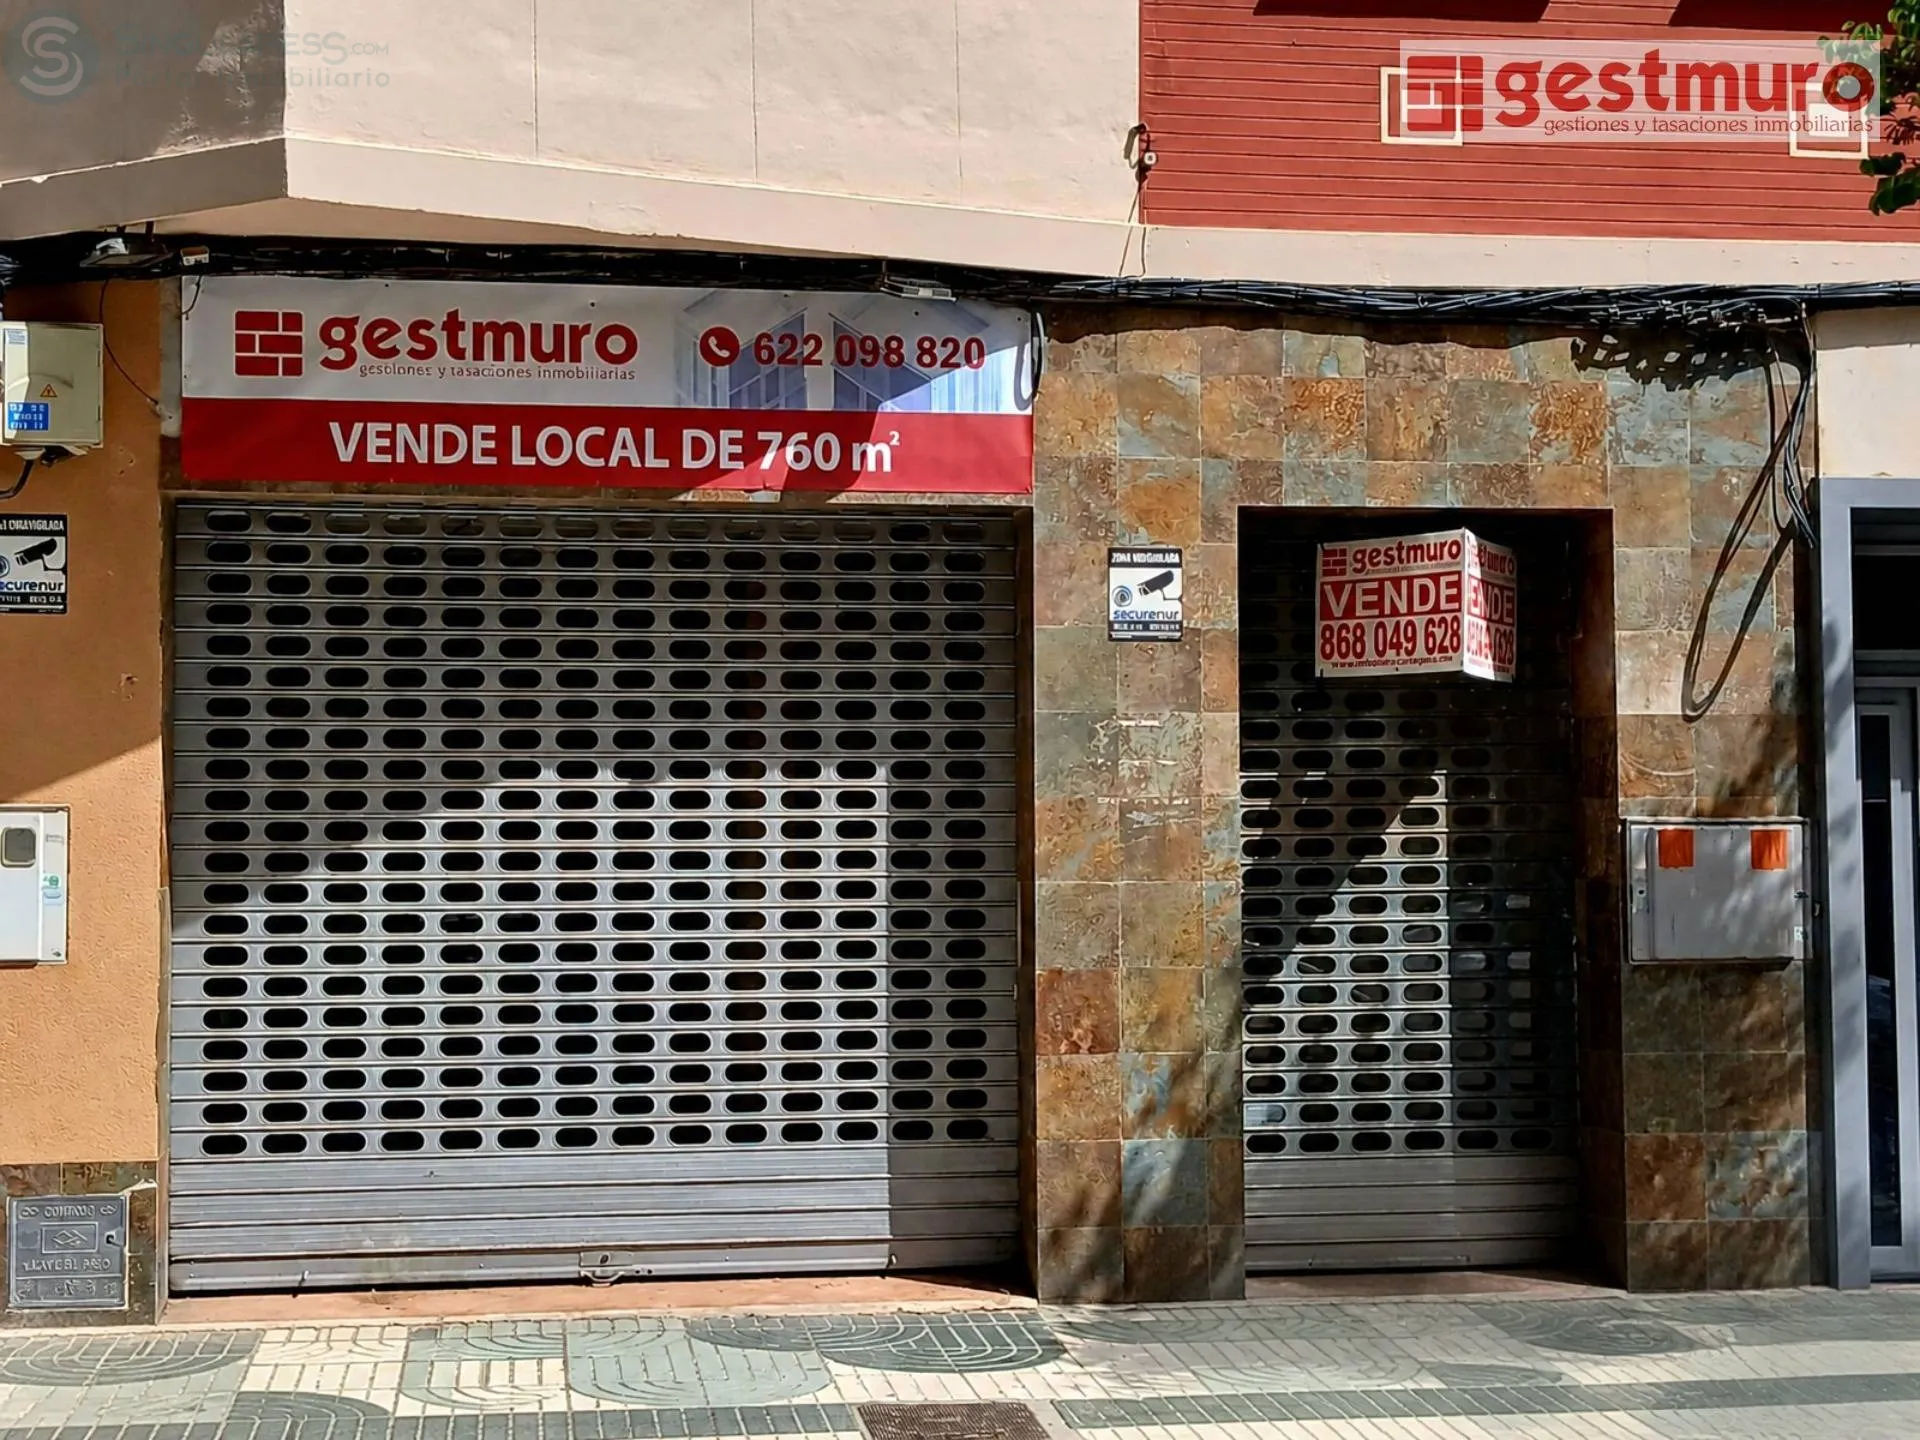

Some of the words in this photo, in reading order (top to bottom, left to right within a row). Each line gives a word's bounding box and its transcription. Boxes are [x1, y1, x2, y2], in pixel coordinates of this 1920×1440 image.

[318, 308, 638, 371] gestmuro
[753, 331, 824, 367] 622
[833, 333, 906, 369] 098
[915, 335, 986, 370] 820
[438, 366, 446, 379] y
[451, 363, 532, 379] tasaciones
[537, 365, 636, 381] inmobiliarias
[328, 421, 497, 465] VENDE
[511, 425, 670, 468] LOCAL
[682, 428, 745, 470] DE
[756, 431, 841, 472] 760
[1352, 539, 1462, 574] gestmuro
[0, 581, 64, 591] ecurenur
[1323, 574, 1460, 618] VENDE
[1469, 578, 1514, 624] ENDE
[1113, 609, 1179, 620] securenur
[1320, 622, 1366, 661] 868
[1374, 619, 1418, 658] 049
[1424, 615, 1461, 656] 628
